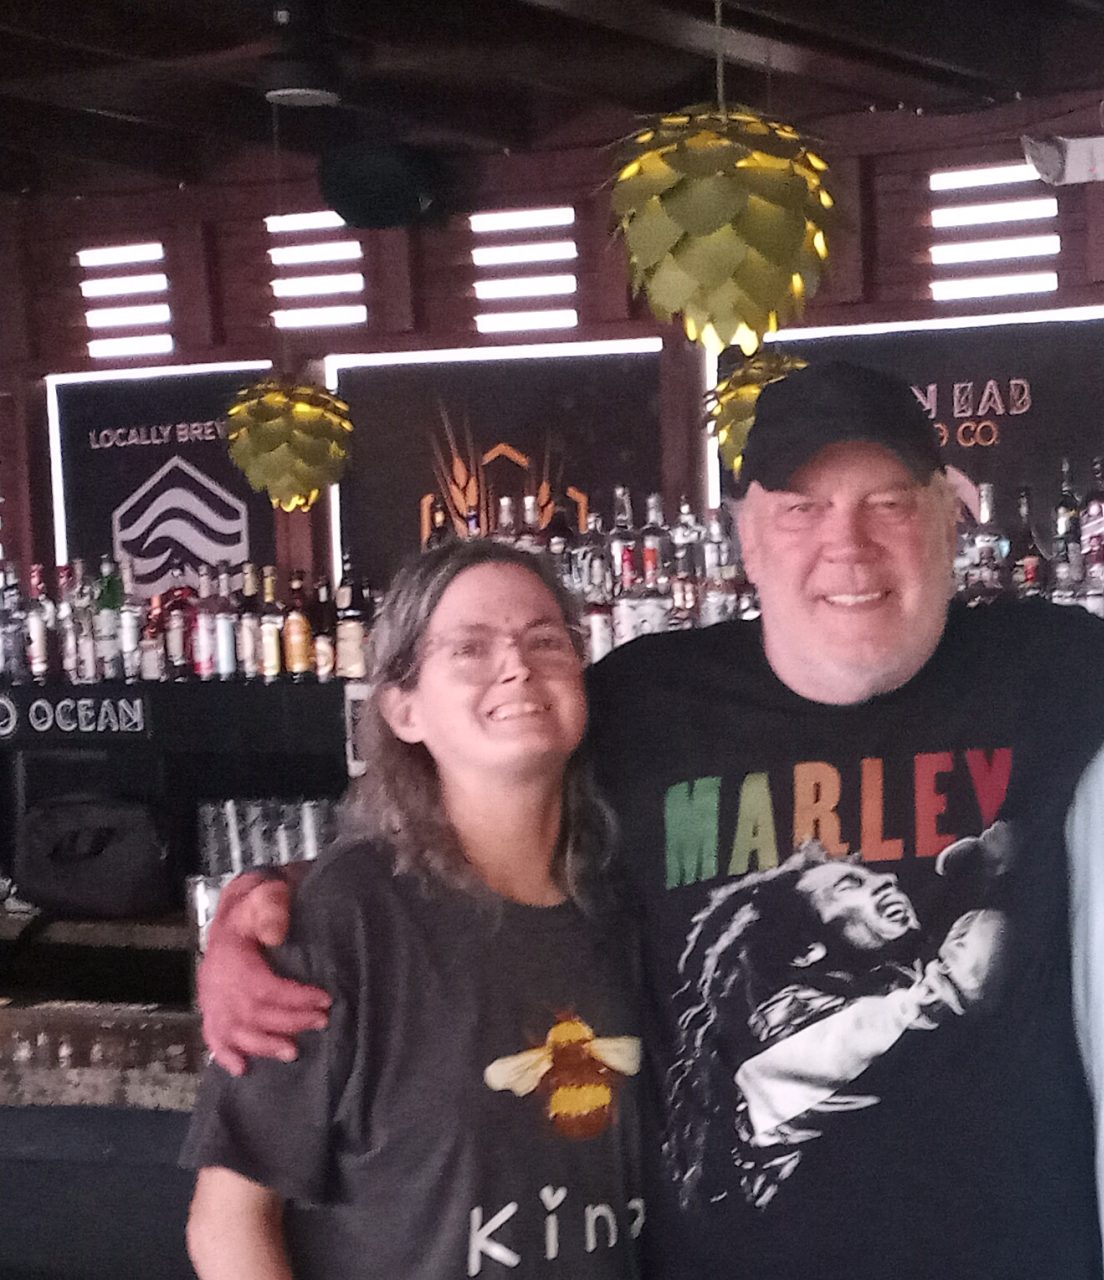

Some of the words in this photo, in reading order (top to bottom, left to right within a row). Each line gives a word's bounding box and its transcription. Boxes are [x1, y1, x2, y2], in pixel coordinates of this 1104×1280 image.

[88, 424, 172, 450] LOCALLY
[29, 698, 144, 732] OCEAN
[663, 747, 1013, 890] MARLEY
